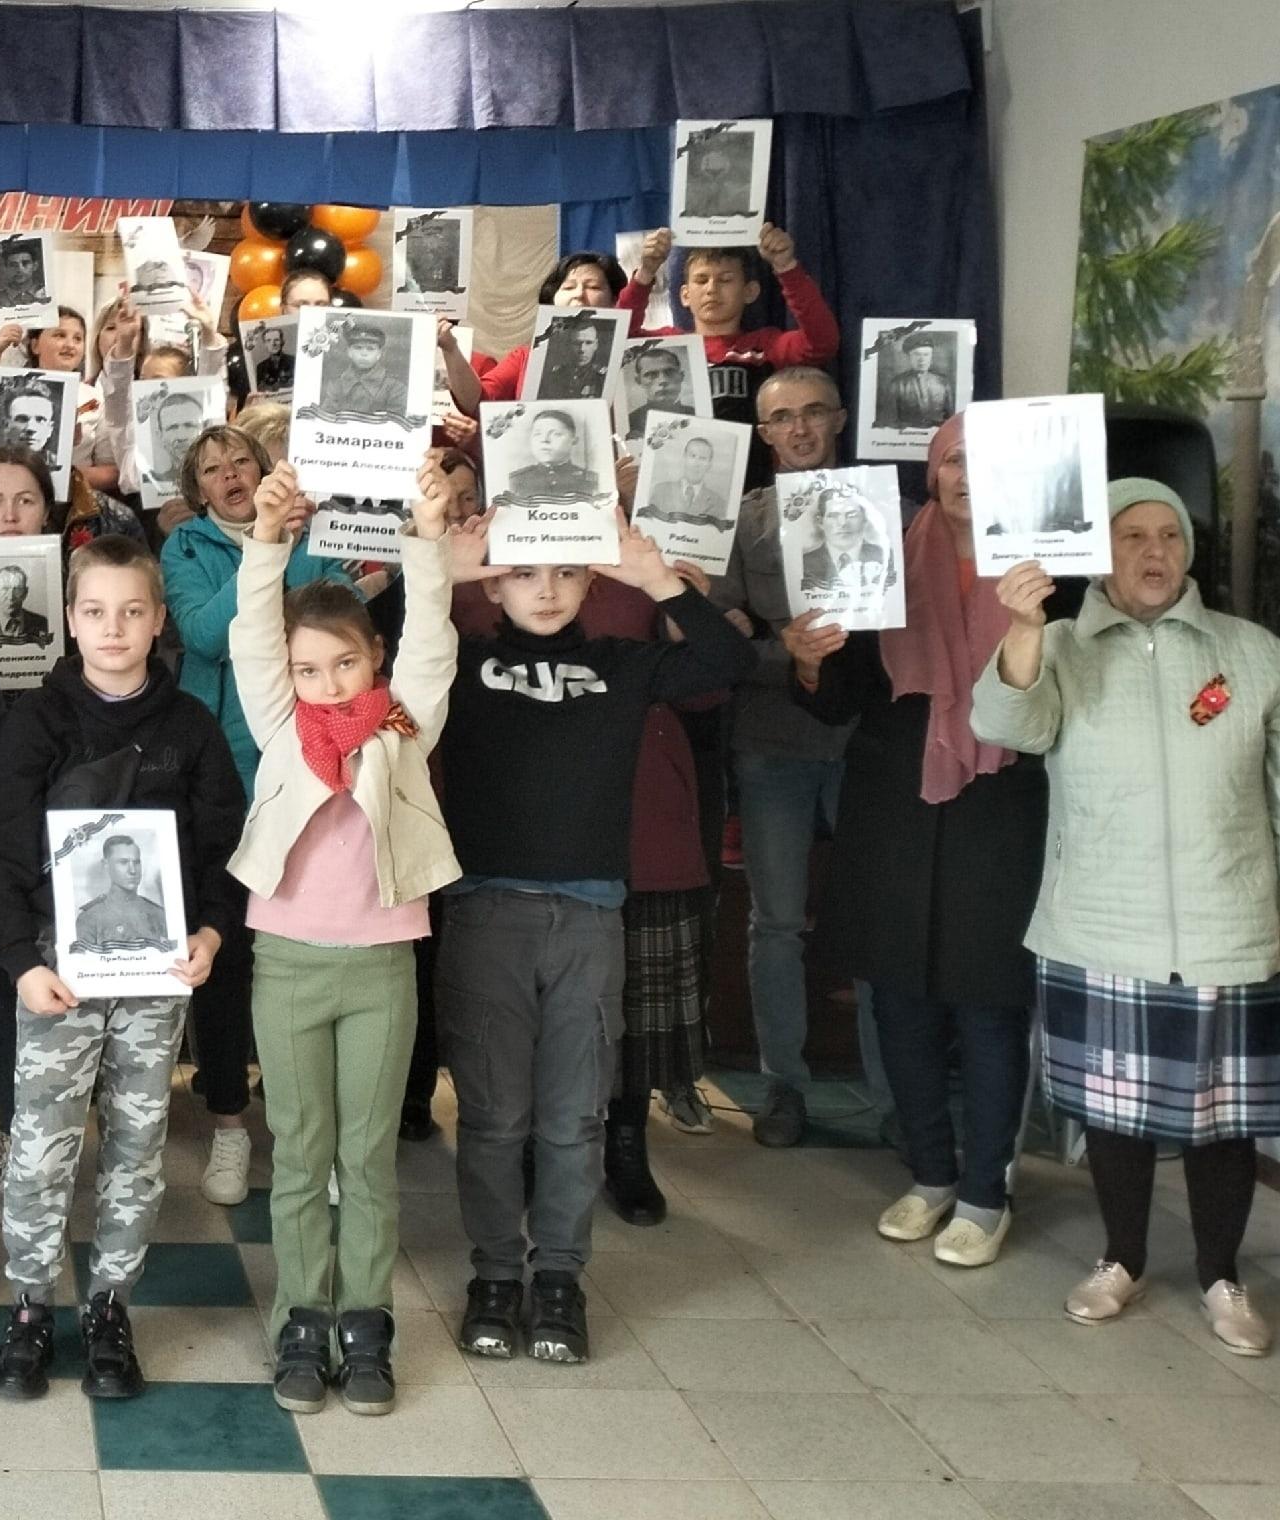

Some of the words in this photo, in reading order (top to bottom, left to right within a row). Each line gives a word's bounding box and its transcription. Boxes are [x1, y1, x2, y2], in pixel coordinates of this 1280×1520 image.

[314, 431, 405, 450] Замараев
[293, 455, 349, 469] Григорий
[527, 509, 580, 521] Косов
[328, 520, 397, 536] Богданов
[506, 534, 538, 544] Петр
[540, 534, 603, 542] Иванович
[319, 540, 344, 551] Петр
[346, 542, 401, 555] Ефимович
